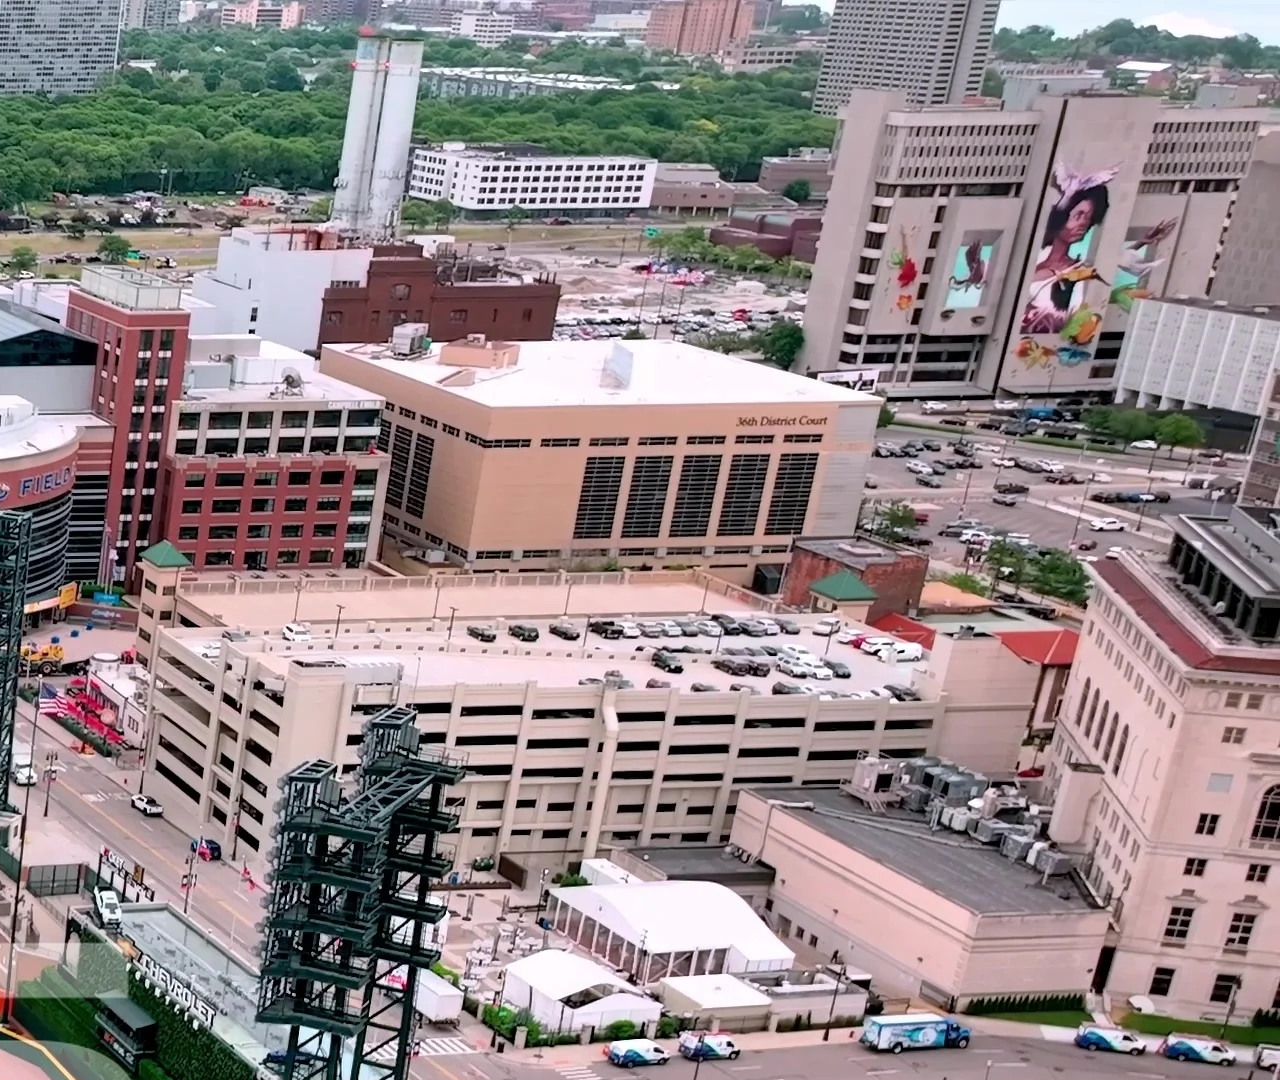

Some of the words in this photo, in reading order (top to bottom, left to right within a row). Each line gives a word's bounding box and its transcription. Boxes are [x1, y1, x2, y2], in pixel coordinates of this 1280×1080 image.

[736, 416, 758, 427] 36th
[760, 415, 797, 427] District
[798, 415, 829, 426] Court
[20, 466, 73, 498] FIELD
[141, 953, 216, 1030] CHEVROLET
